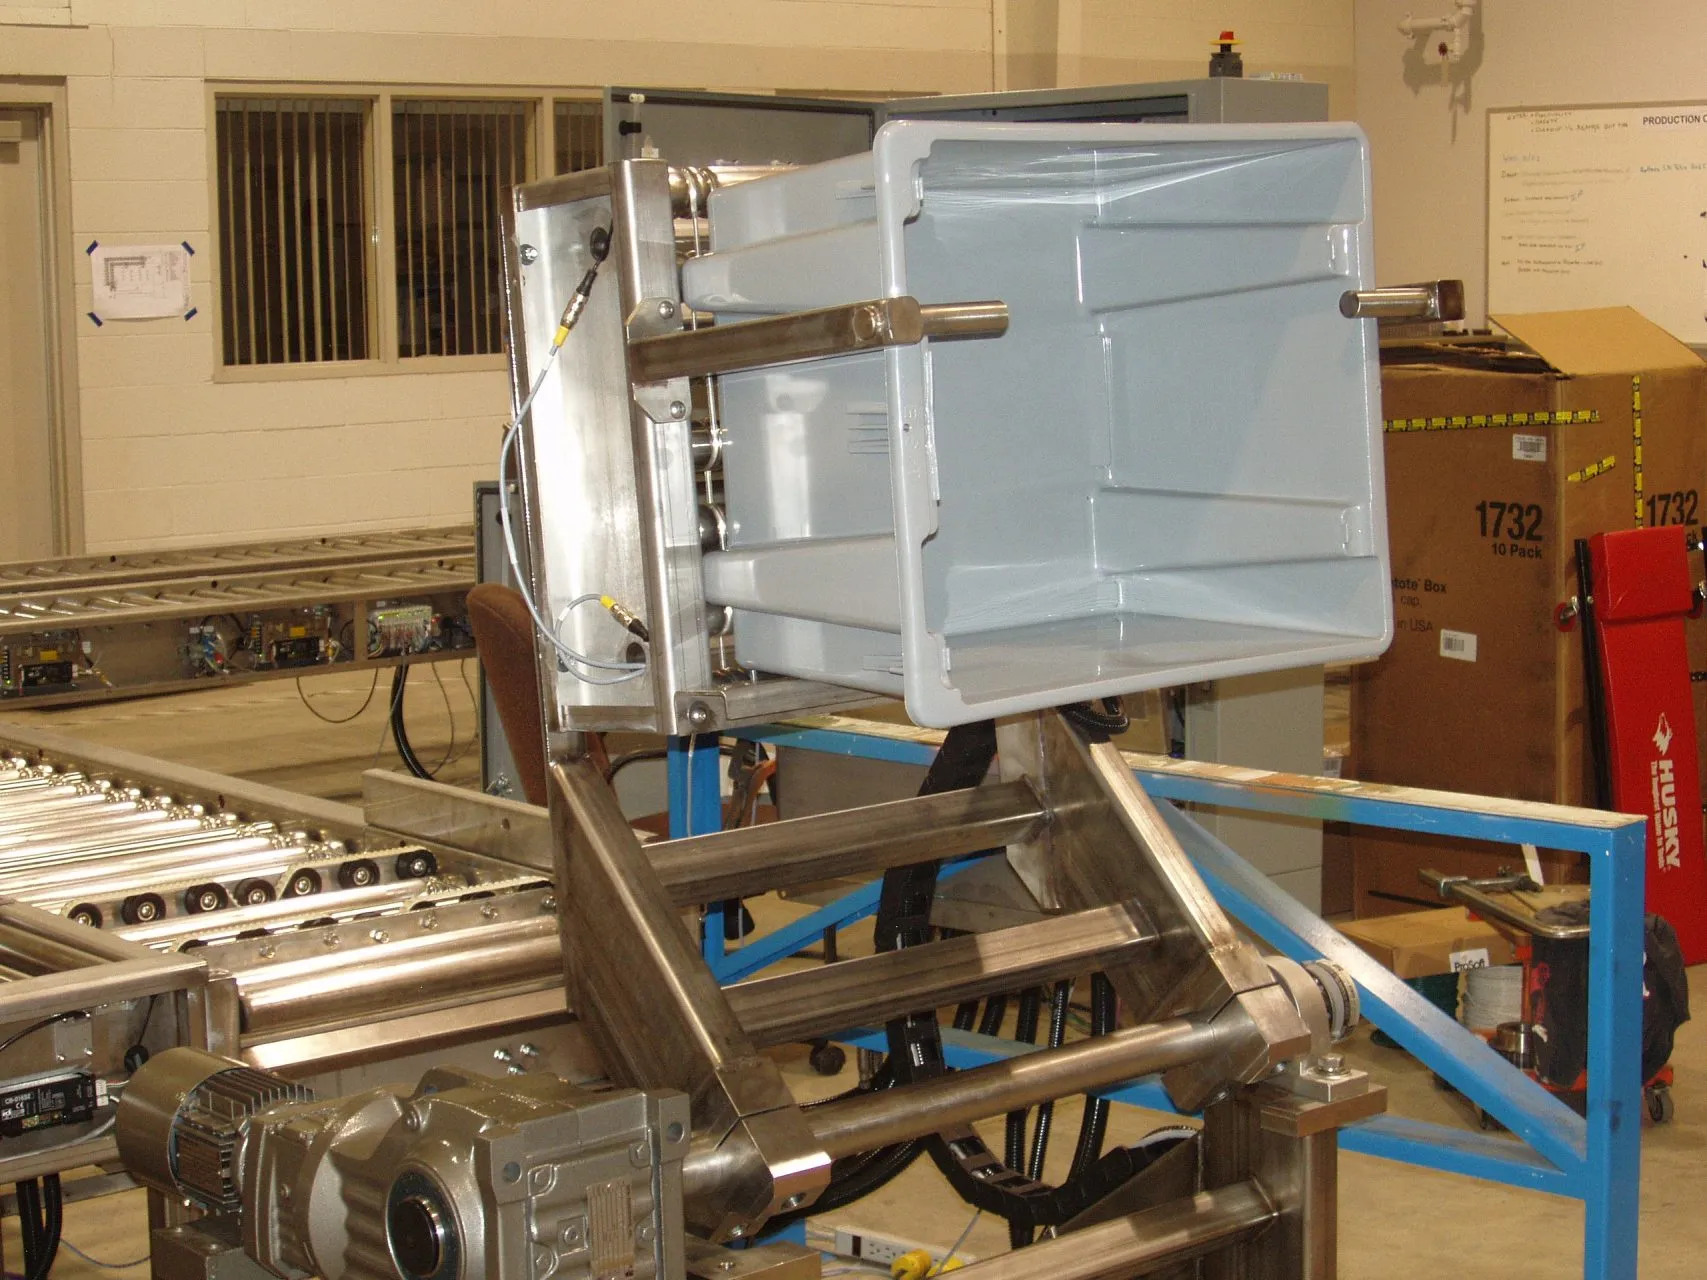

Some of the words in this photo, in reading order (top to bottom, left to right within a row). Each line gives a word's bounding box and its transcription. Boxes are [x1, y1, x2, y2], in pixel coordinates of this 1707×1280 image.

[1643, 114, 1700, 125] PRODUCTION
[1646, 489, 1698, 527] 1732
[1475, 500, 1544, 541] 1732
[1492, 543, 1506, 556] 10
[1510, 543, 1543, 559] Pack
[1424, 578, 1447, 593] Box
[1410, 618, 1433, 632] USA
[1659, 760, 1680, 868] HUSKY
